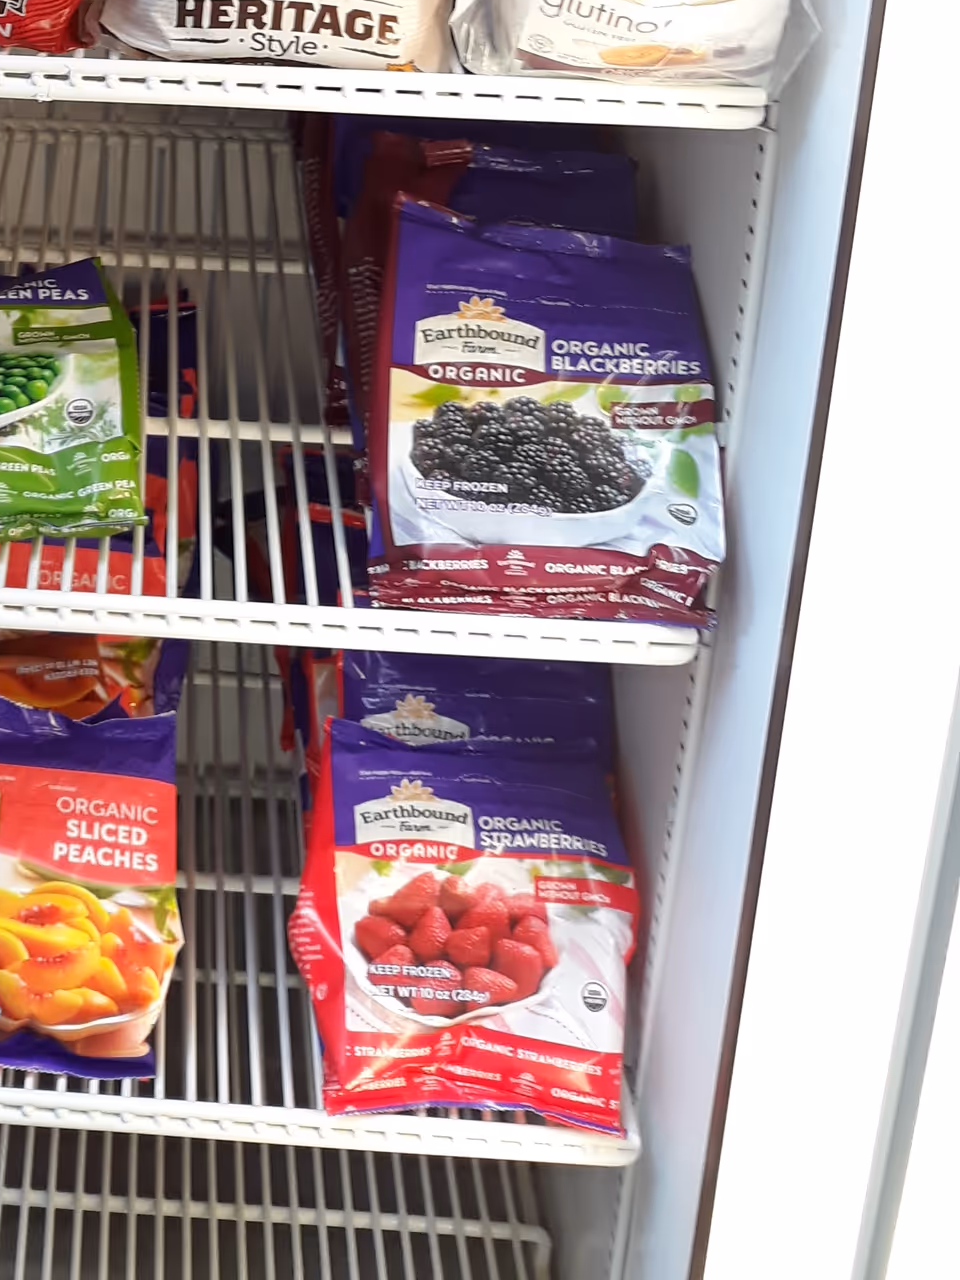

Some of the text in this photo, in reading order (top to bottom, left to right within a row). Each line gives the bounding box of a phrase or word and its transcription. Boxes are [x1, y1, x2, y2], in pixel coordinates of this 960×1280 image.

[249, 32, 319, 58] Style
[38, 287, 90, 302] PEAS
[420, 323, 540, 351] Earthbound
[460, 341, 500, 355] Farm
[550, 339, 650, 358] ORGANIC
[427, 364, 527, 384] ORGANIC
[550, 356, 702, 376] BLACKBERRIES
[30, 464, 57, 477] PEAS
[23, 489, 75, 500] ORGANIC
[77, 481, 115, 498] GREEN
[415, 477, 509, 494] KEEP FROZEN
[544, 561, 607, 576] ORGANIC
[55, 795, 159, 825] ORGANIC
[359, 805, 470, 825] Earthbound
[65, 820, 148, 846] SLICED
[399, 820, 433, 832] Farm
[477, 815, 563, 832] ORGANIC
[369, 842, 459, 860] ORGANIC
[479, 831, 608, 858] STRAWBERRIES
[52, 844, 159, 872] PEACHES
[538, 881, 577, 891] GROWN
[538, 890, 580, 902] WITHOUT
[368, 963, 452, 979] KEEP FROZEN
[370, 985, 434, 999] NET WT 10
[460, 1036, 603, 1077] ORGANIC STRAWBERRIES
[550, 1086, 607, 1109] ORGANIC
